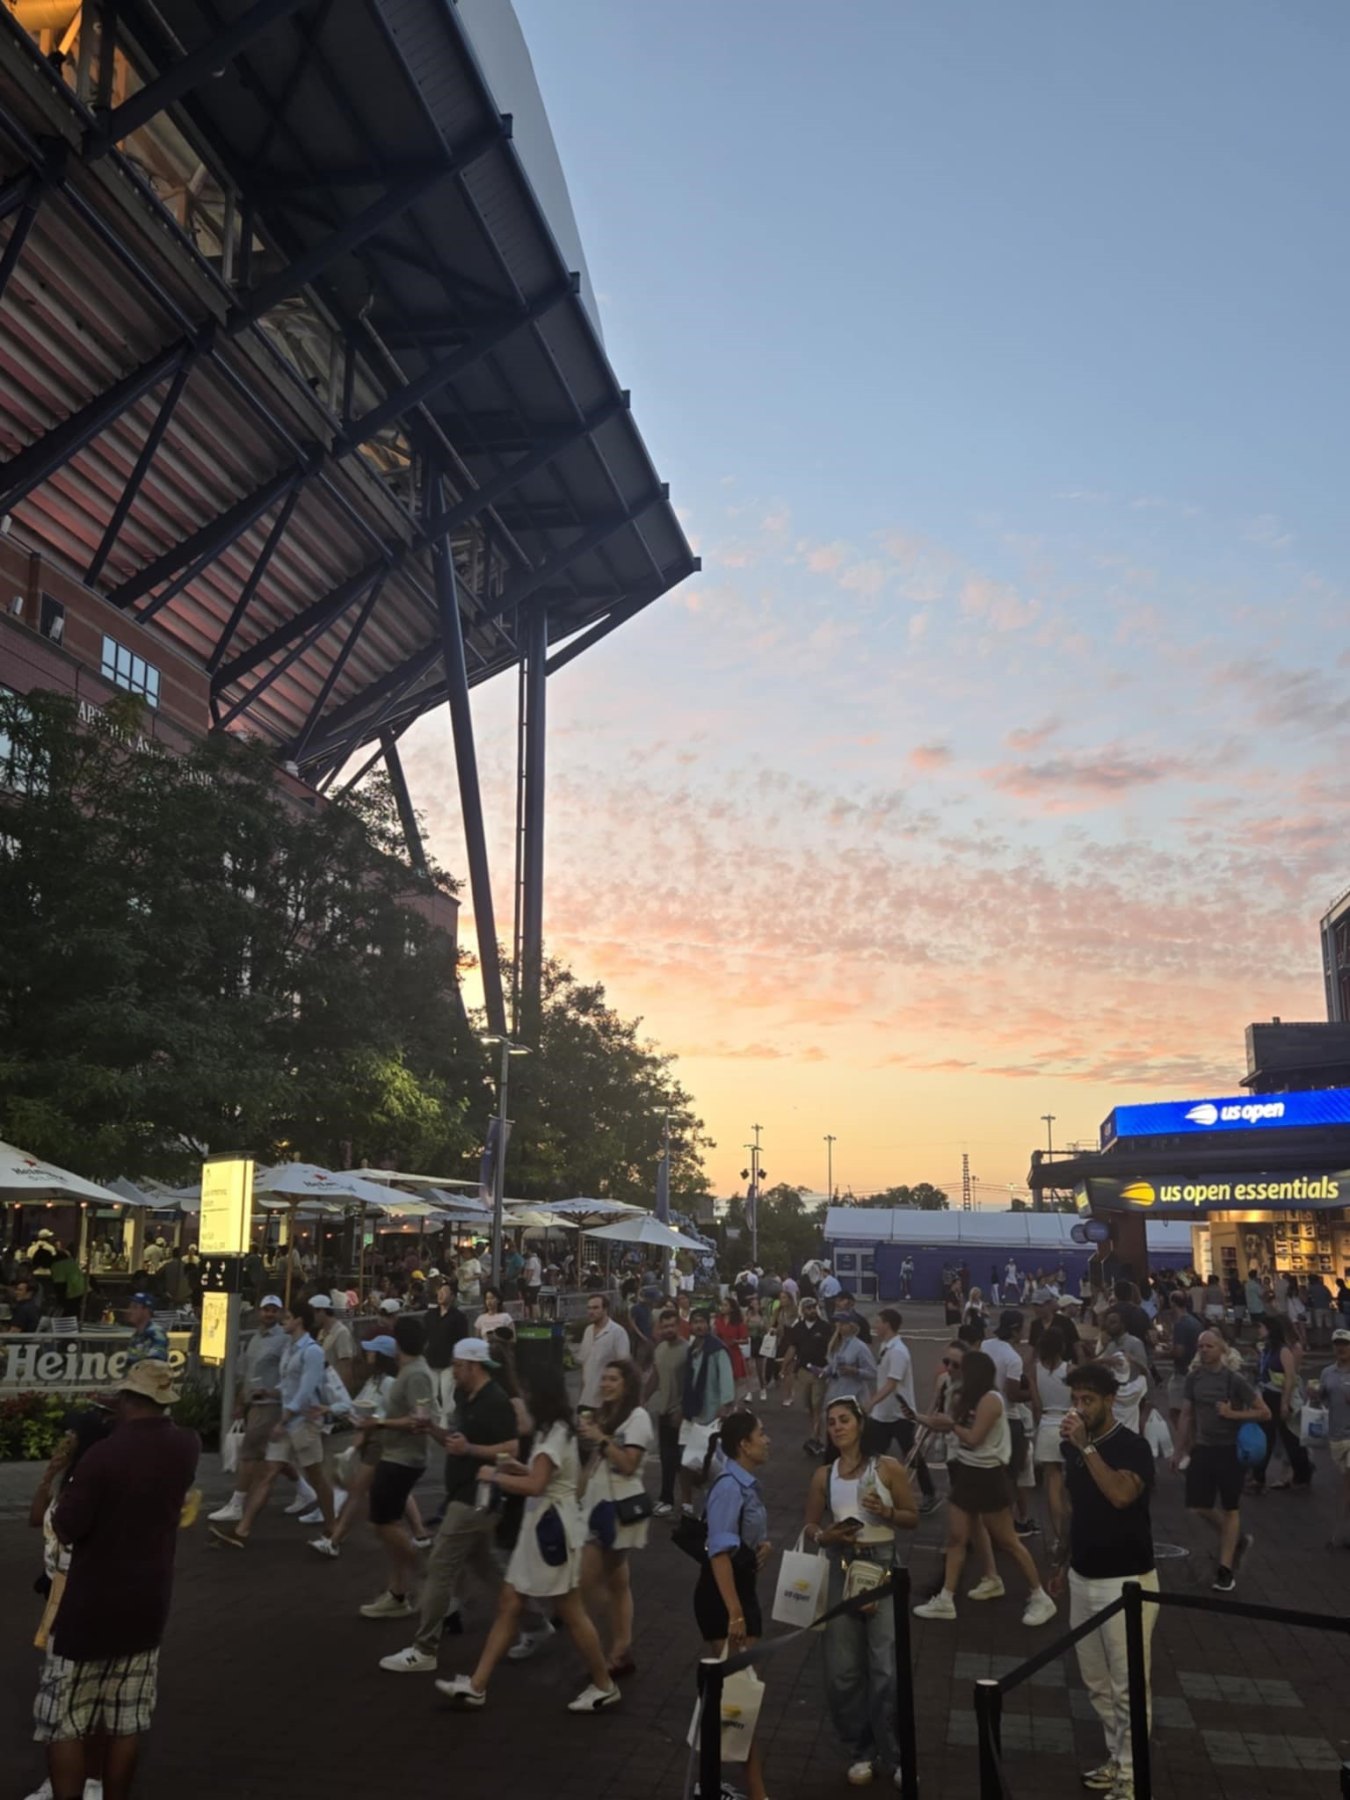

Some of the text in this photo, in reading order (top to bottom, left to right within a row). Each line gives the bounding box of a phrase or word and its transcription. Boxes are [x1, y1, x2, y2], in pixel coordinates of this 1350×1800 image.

[1160, 1175, 1339, 1207] us open essentials
